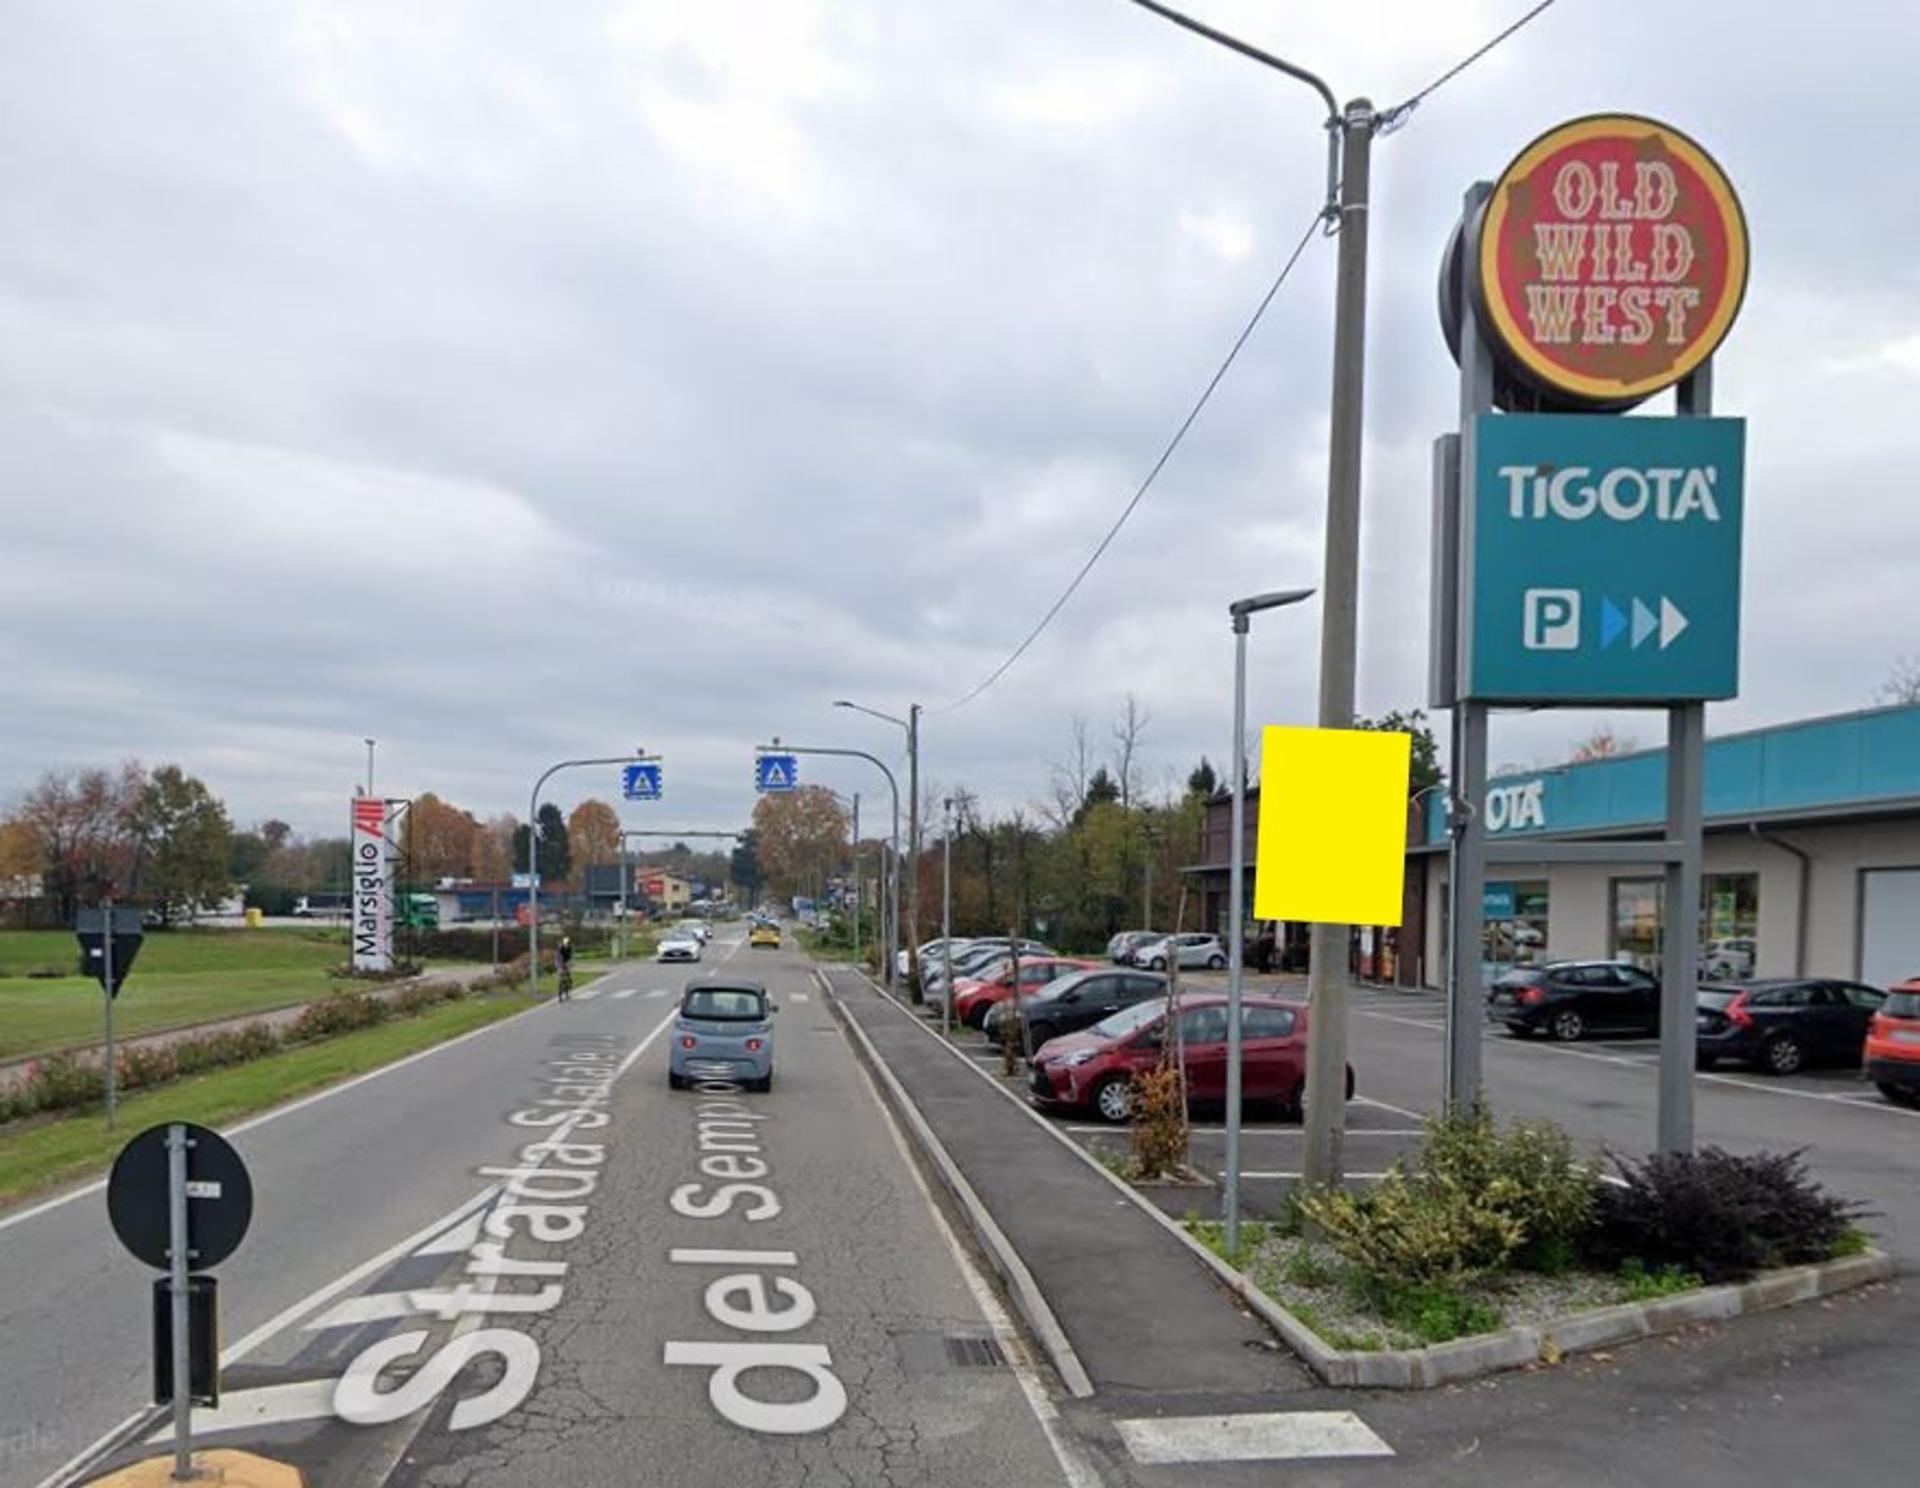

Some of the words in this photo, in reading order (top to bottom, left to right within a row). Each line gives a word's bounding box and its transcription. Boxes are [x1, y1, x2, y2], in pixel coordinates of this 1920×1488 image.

[1553, 161, 1678, 220] OLD
[1534, 223, 1695, 283] WILD
[1526, 285, 1702, 344] WEST
[1536, 596, 1571, 644] P
[354, 843, 383, 956] Marsiglio
